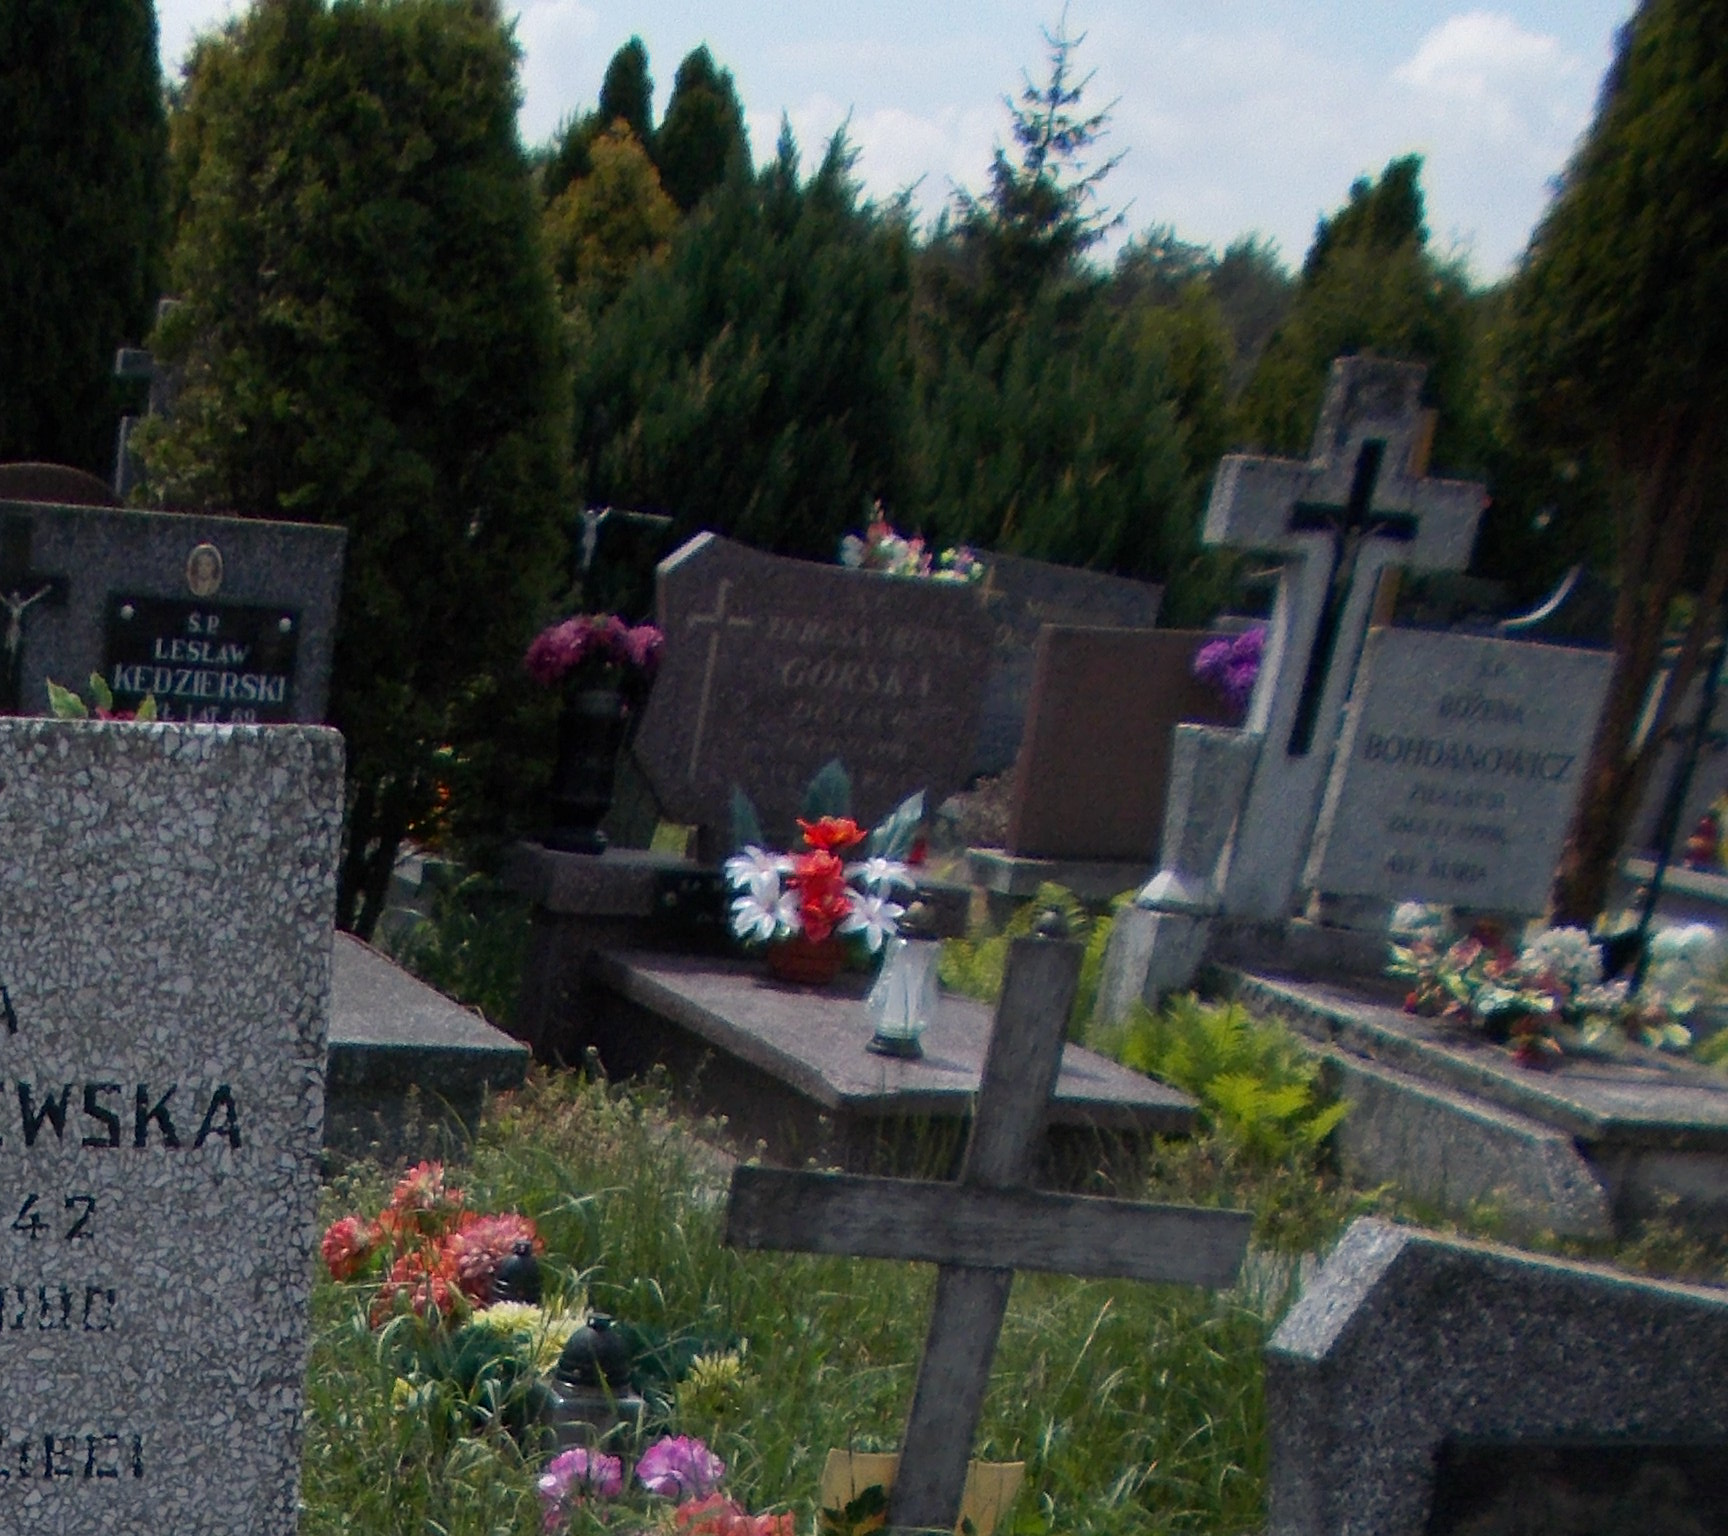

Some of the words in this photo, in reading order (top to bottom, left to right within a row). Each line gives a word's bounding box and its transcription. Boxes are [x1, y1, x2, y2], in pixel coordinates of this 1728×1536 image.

[154, 637, 250, 665] LESŁAW
[1363, 732, 1575, 782] BOHDANOWICZ
[9, 1193, 98, 1241] 42
